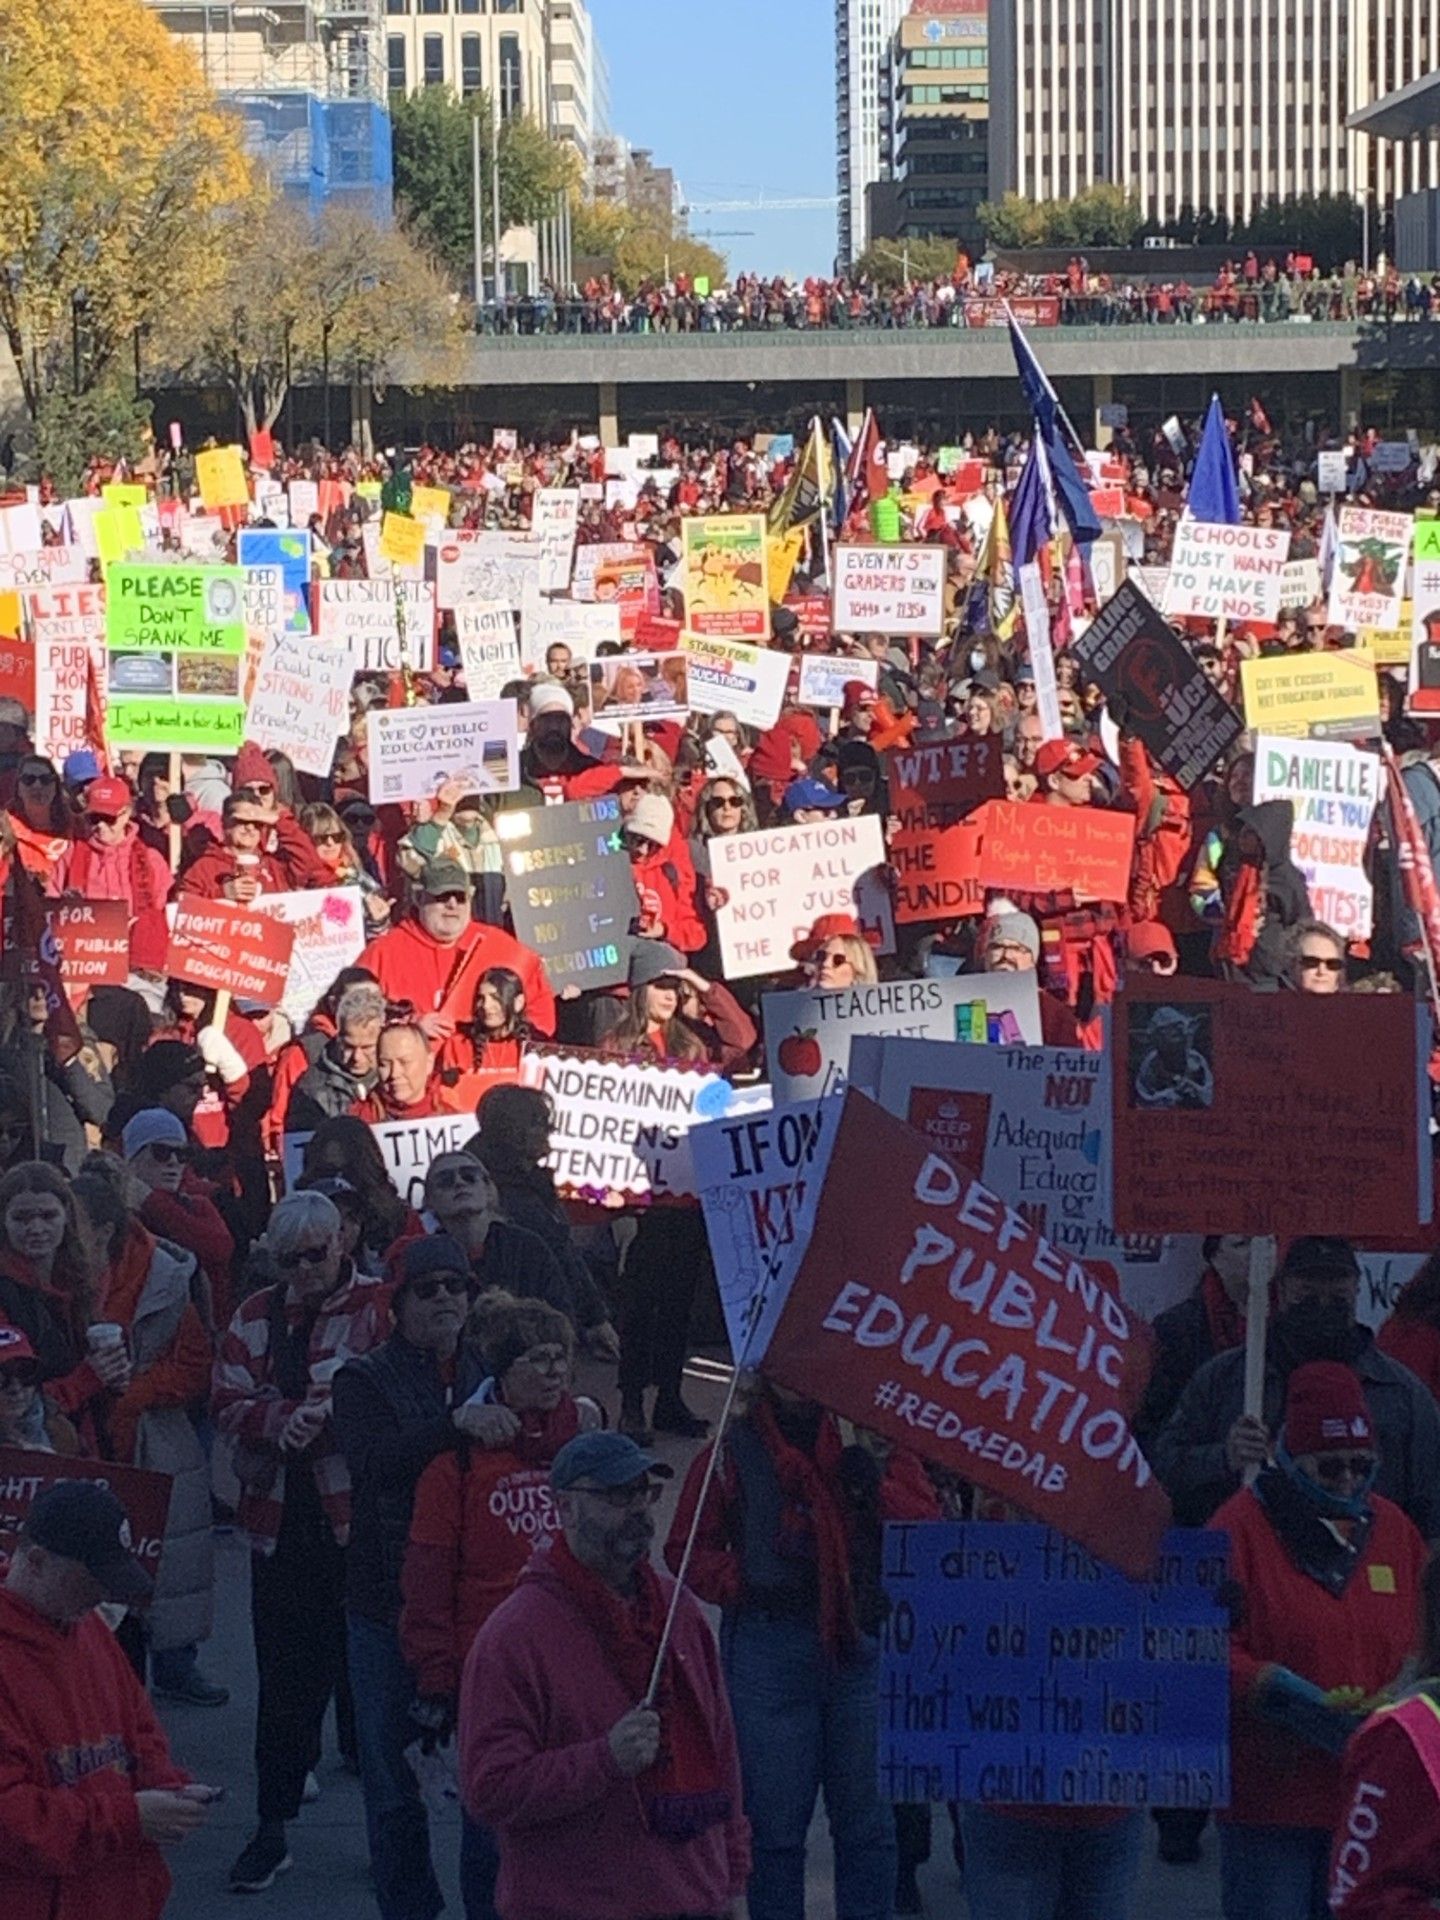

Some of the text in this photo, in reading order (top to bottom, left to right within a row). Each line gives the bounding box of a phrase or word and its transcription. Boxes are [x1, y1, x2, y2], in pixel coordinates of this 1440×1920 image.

[1180, 526, 1278, 549] SCHOOLS
[847, 553, 883, 569] EVEN
[887, 553, 904, 569] MY
[1177, 548, 1286, 576] JUST WANT
[122, 576, 204, 598] PLEASE
[845, 574, 938, 592] GRADERS KNOW
[1173, 572, 1196, 590] TO
[1209, 575, 1265, 597] HAVE
[1192, 596, 1265, 617] FUNDS
[463, 610, 513, 633] FIGHT
[1076, 586, 1137, 661] FAILING
[123, 627, 224, 646] SPANK ME
[1092, 607, 1146, 673] GRADE
[466, 642, 515, 665] RIGHT
[688, 640, 751, 663] STAND FOR
[259, 672, 314, 703] STRONG
[50, 695, 73, 712] IS
[285, 702, 302, 720] by
[380, 721, 489, 742] WE PUBLIC
[380, 737, 475, 756] EDUCATION
[1268, 750, 1374, 802] DANIELLE,
[579, 799, 619, 823] KIDS
[995, 805, 1025, 843] My
[1306, 798, 1335, 825] ARE
[1339, 801, 1369, 830] YOU
[725, 826, 857, 863] EDUCATION
[889, 844, 936, 872] THE
[740, 856, 854, 892] FOR ALL
[60, 906, 95, 927] FOR
[732, 889, 853, 923] NOT JUS
[176, 913, 264, 942] FIGHT FOR
[74, 937, 129, 954] PUBLIC
[734, 938, 773, 961] THE
[184, 958, 267, 993] EDUCATION
[239, 950, 290, 977] PUBLIC
[813, 983, 943, 1021] TEACHERS
[997, 1049, 1045, 1072] The
[1045, 1073, 1098, 1108] NOT
[926, 1119, 972, 1134] KEEP
[384, 1124, 462, 1167] TIME
[722, 1120, 770, 1180] IF
[1062, 1194, 1093, 1214] or
[914, 1150, 1129, 1340] DEFEND
[900, 1223, 1125, 1389] PUBLIC
[823, 1280, 1153, 1490] EDUCATION
[874, 1381, 1069, 1494] #RED4EDAB
[888, 1525, 917, 1581] I
[940, 1535, 1019, 1583] drew
[930, 1620, 968, 1675] yr
[986, 1609, 1027, 1656] old
[1048, 1624, 1126, 1679] paper
[882, 1672, 1164, 1734] that was the last
[947, 1745, 970, 1802] I
[979, 1745, 1047, 1803] could
[1060, 1748, 1150, 1804] afford
